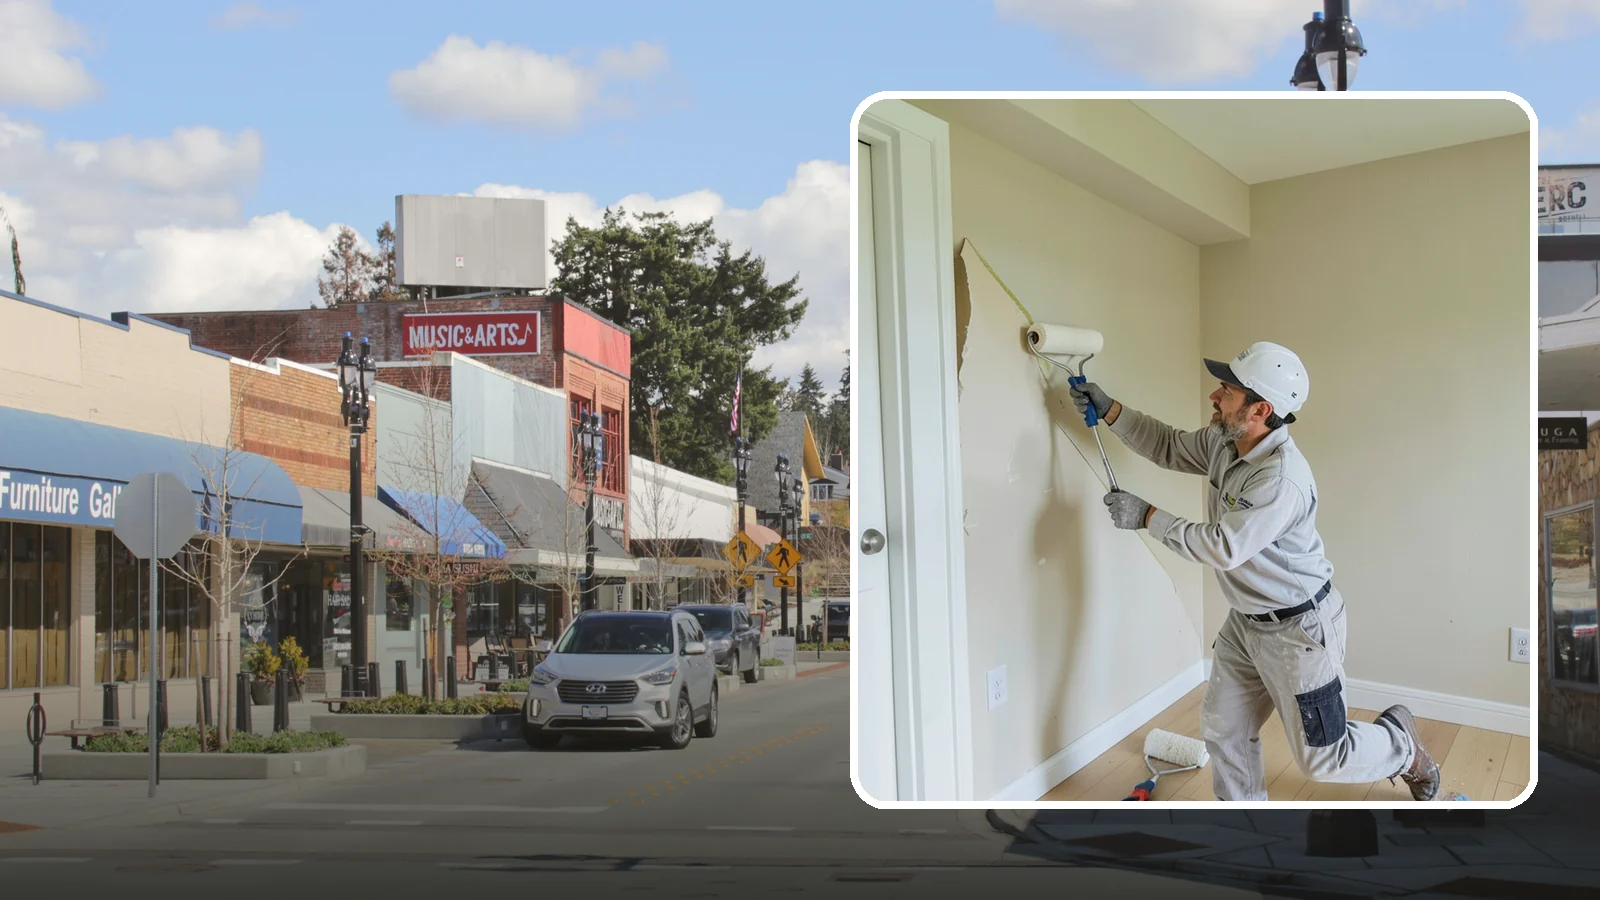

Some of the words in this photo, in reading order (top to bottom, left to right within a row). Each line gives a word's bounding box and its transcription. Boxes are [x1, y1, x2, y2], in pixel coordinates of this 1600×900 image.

[409, 323, 519, 348] MUSIC&ARTS
[1540, 428, 1577, 436] UGA
[0, 471, 79, 515] Furniture
[89, 482, 121, 519] Gal
[453, 563, 478, 573] SUSHI
